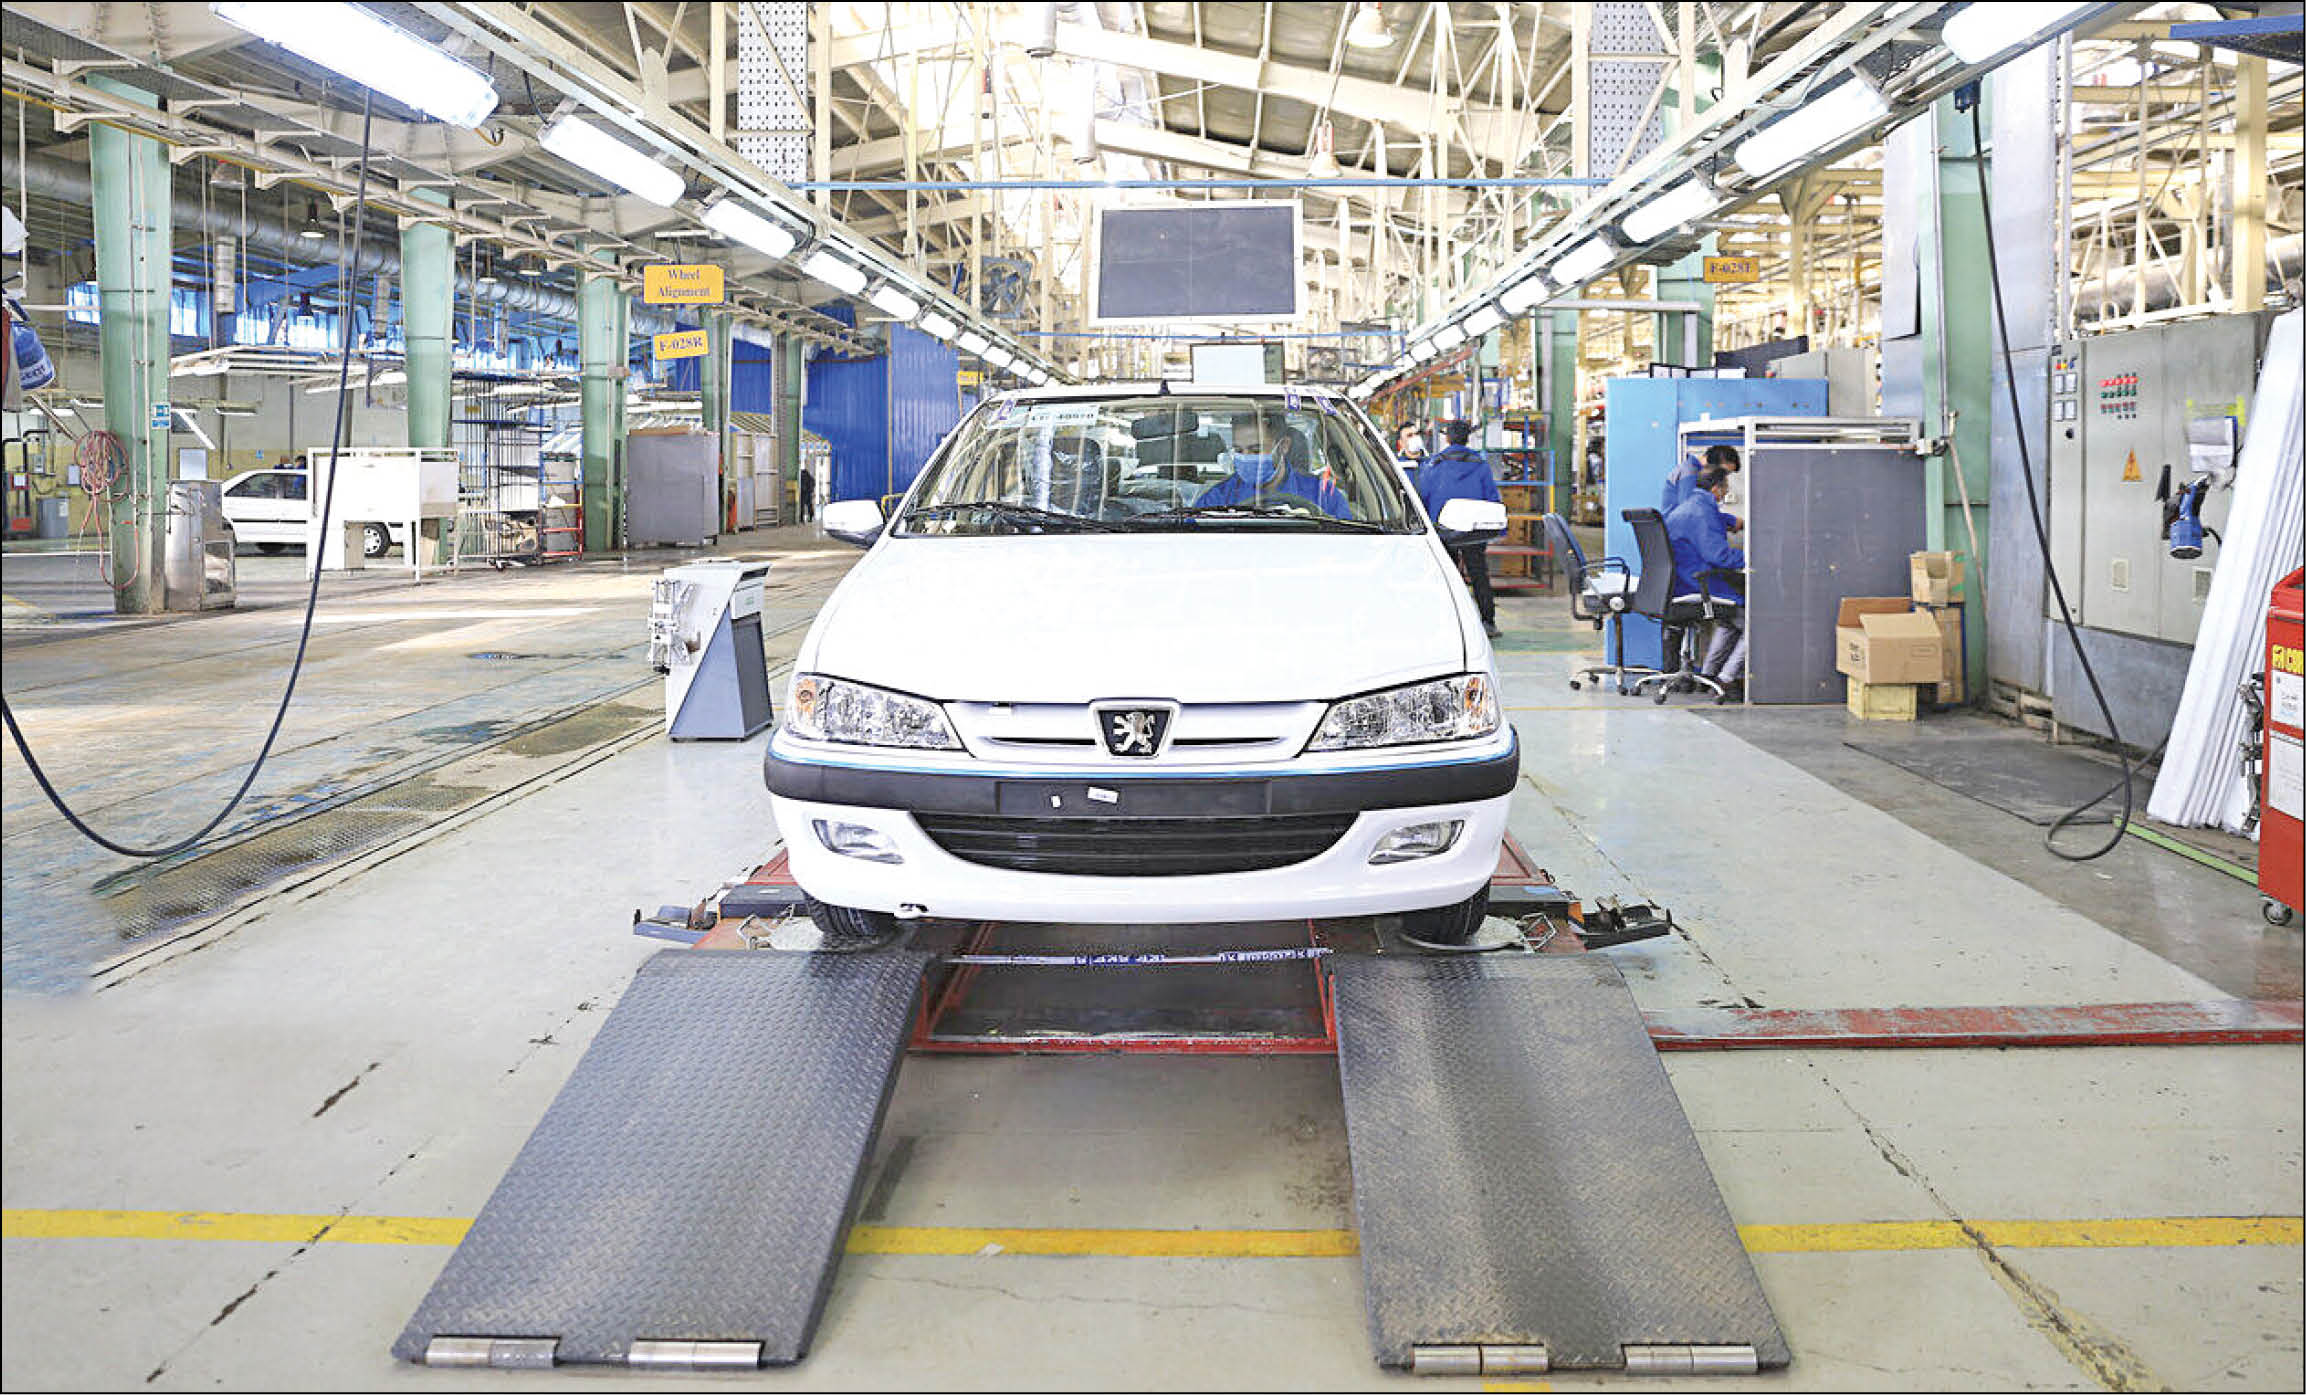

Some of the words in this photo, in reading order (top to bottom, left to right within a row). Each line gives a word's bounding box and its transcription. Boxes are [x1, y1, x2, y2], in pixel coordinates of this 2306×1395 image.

[667, 268, 700, 280] Wheel
[658, 286, 711, 299] Alignment
[659, 336, 705, 352] F-028R
